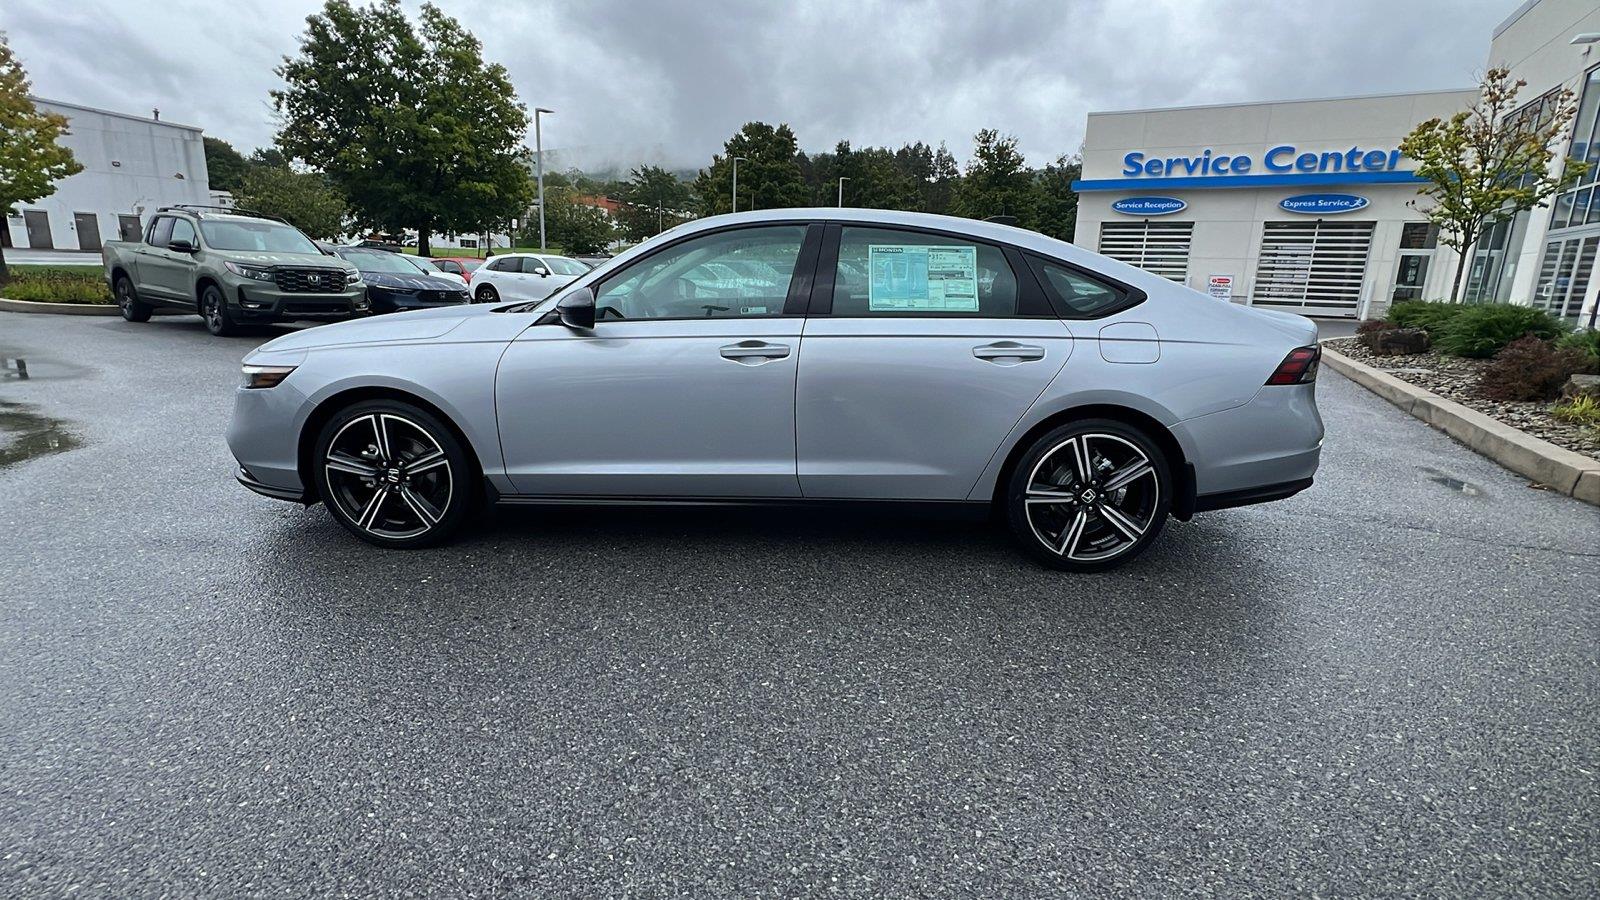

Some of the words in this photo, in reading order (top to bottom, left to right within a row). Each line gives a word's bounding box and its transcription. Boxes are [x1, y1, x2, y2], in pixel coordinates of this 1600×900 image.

[1123, 149, 1252, 177] Service
[1264, 146, 1401, 172] Center
[1116, 201, 1143, 209] Service
[1144, 201, 1182, 210] Reception
[1283, 200, 1316, 208] Express
